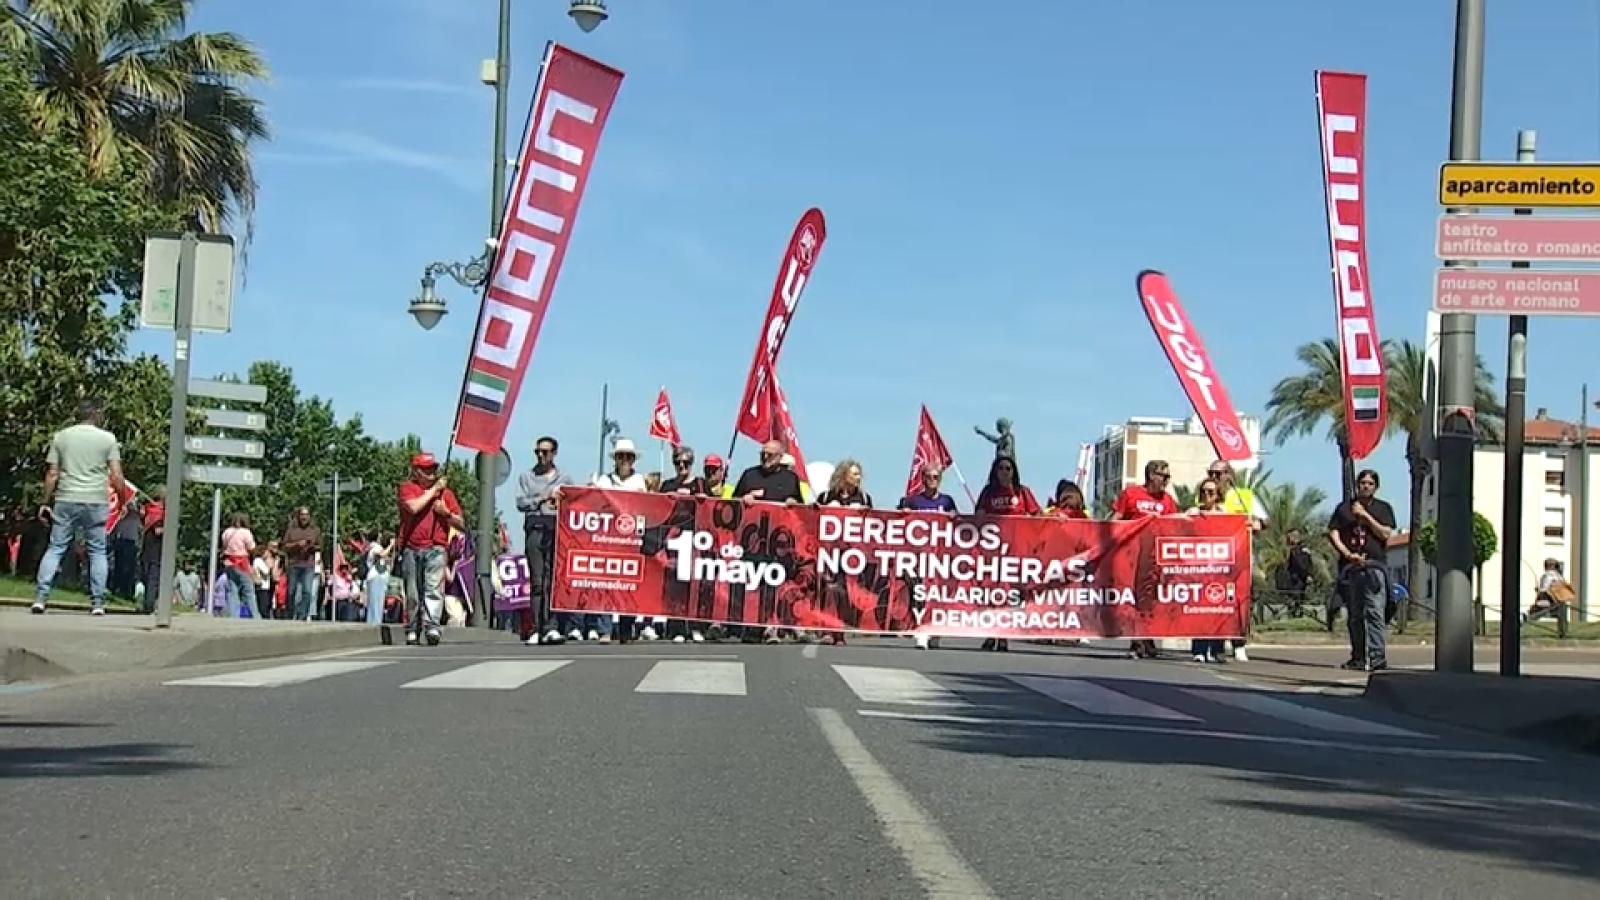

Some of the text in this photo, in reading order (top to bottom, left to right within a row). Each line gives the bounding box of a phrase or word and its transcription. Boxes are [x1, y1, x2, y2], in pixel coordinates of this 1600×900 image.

[1446, 177, 1595, 197] aparcamiento
[1444, 223, 1498, 237] teatro
[1442, 240, 1529, 253] anfiteatro
[1441, 277, 1579, 292] museo nacional
[1441, 292, 1580, 308] de arte romano
[1144, 294, 1217, 411] UGT
[569, 510, 614, 533] UGT
[819, 514, 1009, 555] DERECHOS,
[721, 541, 744, 559] de
[1162, 543, 1229, 559] CCOO
[573, 555, 638, 576] CCOO
[694, 557, 786, 590] mayo
[816, 547, 1095, 584] NO TRINCHERAS.
[571, 578, 637, 591] extremadura
[1157, 583, 1203, 604] UGT
[912, 584, 1026, 608] SALARIOS,
[1032, 587, 1136, 606] VIVIENDA
[912, 608, 1081, 629] Y DEMOCRACIA
